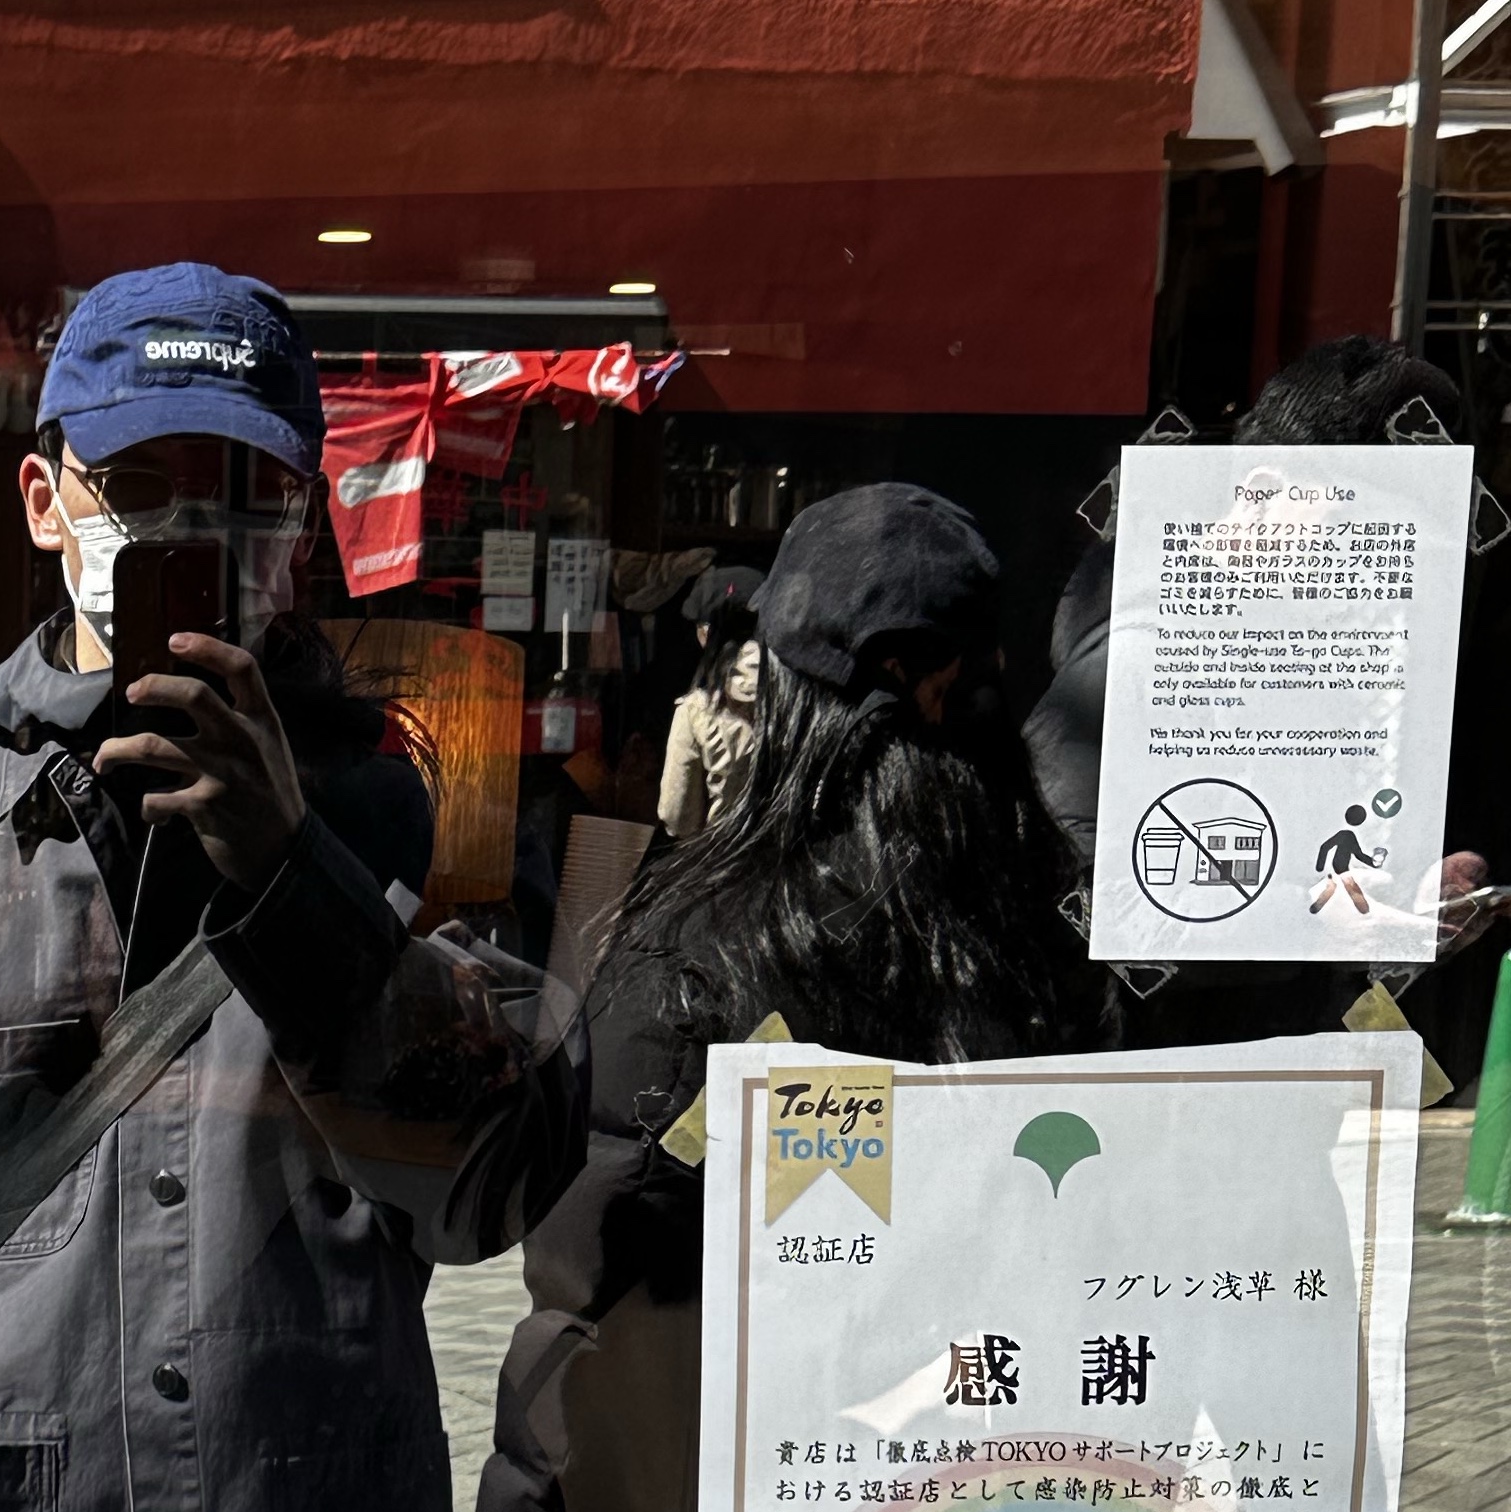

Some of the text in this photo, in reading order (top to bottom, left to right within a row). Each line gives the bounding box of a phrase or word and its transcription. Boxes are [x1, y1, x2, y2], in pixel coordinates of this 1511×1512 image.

[1233, 485, 1357, 505] Paper Cup Use
[774, 1083, 884, 1135] Tokyo
[772, 1127, 885, 1168] Tokyo
[776, 1233, 876, 1266] 認証店
[1083, 1268, 1329, 1302] フグレン浅草 様
[945, 1334, 1156, 1407] 感謝
